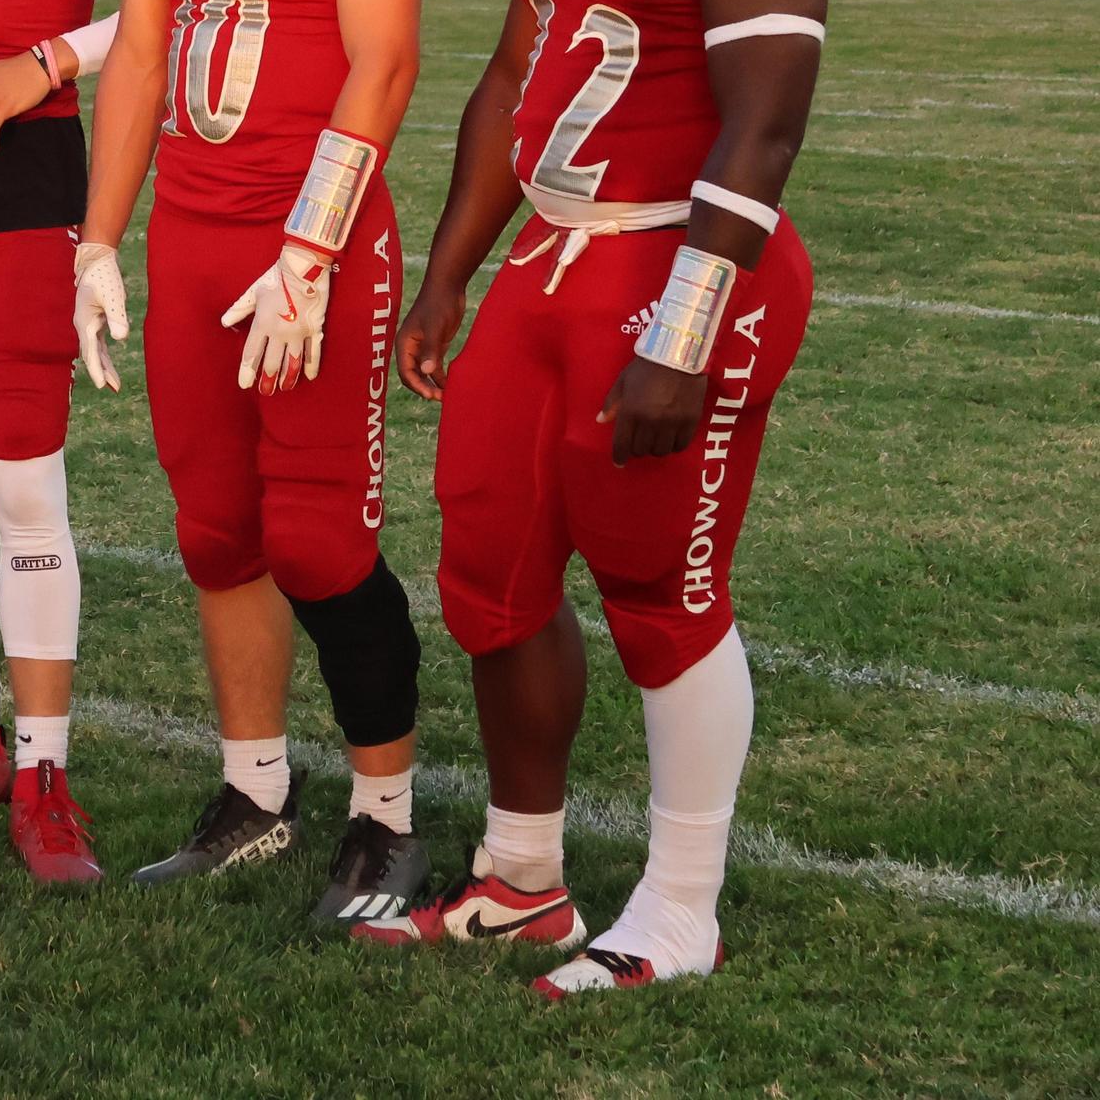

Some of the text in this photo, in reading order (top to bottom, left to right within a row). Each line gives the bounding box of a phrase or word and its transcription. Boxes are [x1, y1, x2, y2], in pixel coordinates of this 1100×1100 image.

[362, 227, 392, 529] CHOWCHILLA
[681, 303, 767, 615] CHOWCHILLA
[13, 556, 59, 570] BATTLE
